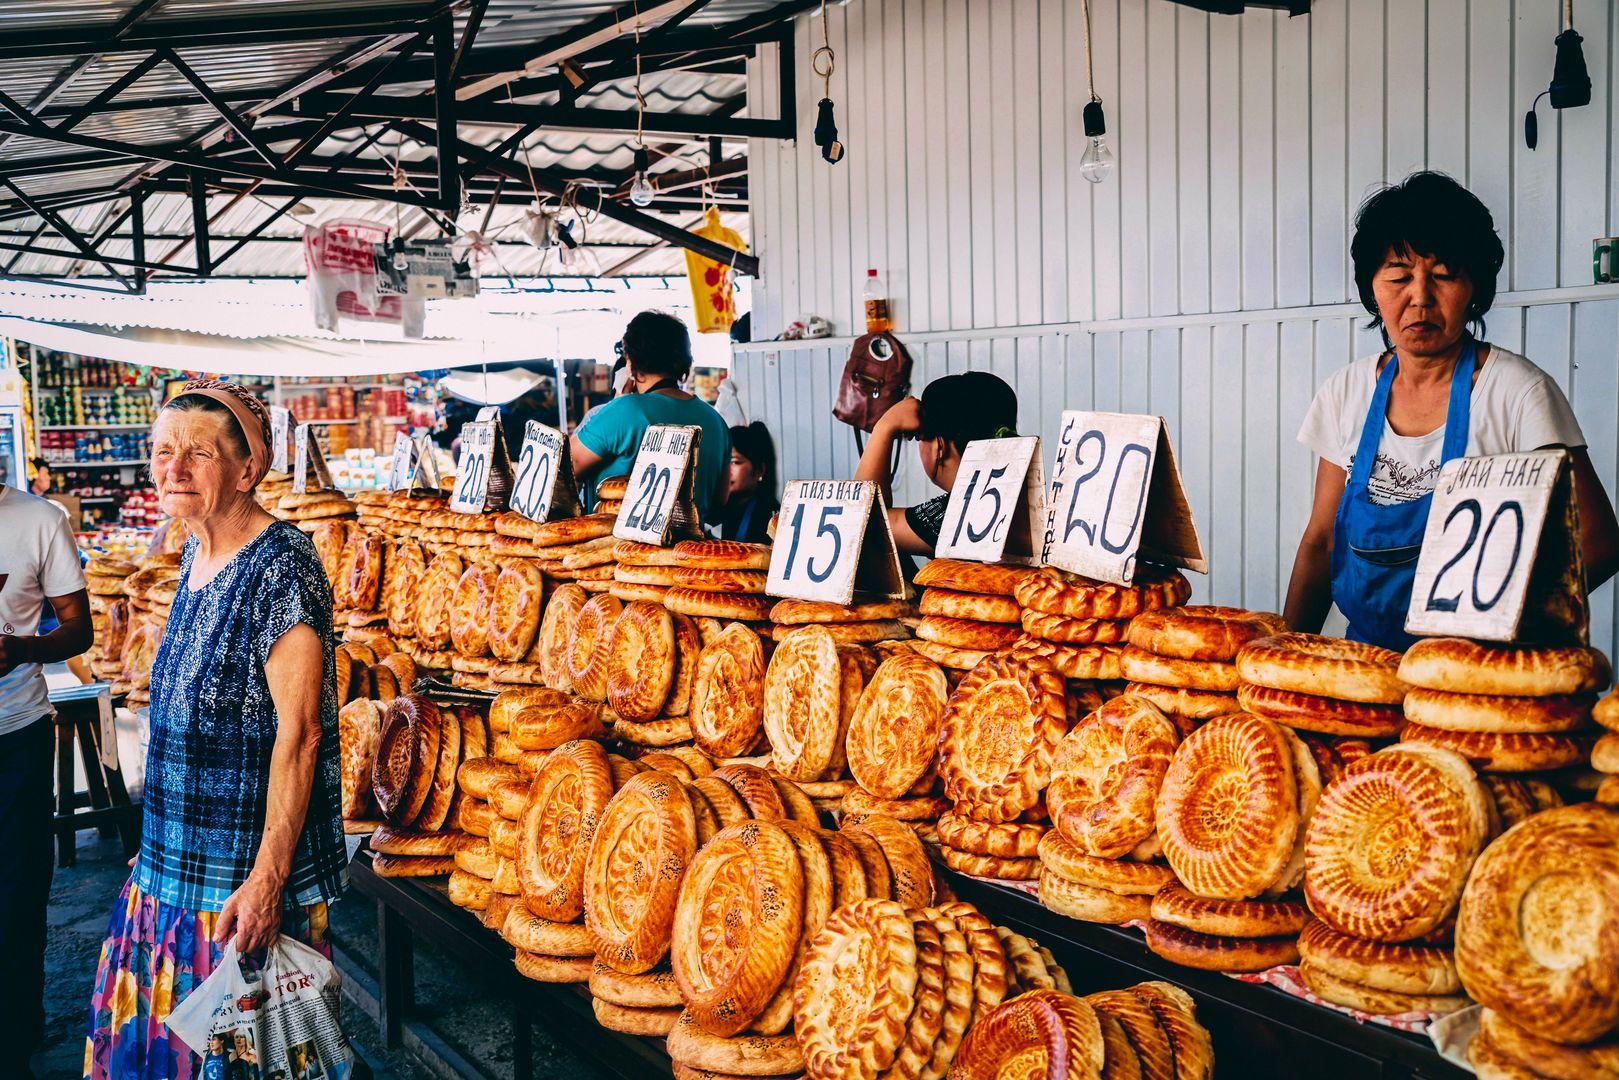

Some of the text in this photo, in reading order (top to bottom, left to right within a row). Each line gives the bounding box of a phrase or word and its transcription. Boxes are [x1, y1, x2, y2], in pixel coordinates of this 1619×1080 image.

[459, 453, 484, 504] 20
[511, 444, 549, 518] 20
[625, 463, 670, 532] 20
[1063, 430, 1151, 554] 20
[1446, 457, 1494, 494] МАЙ
[1500, 458, 1546, 487] НАН
[783, 503, 843, 583] 15
[1425, 498, 1524, 613] 20
[275, 977, 311, 997] TOR
